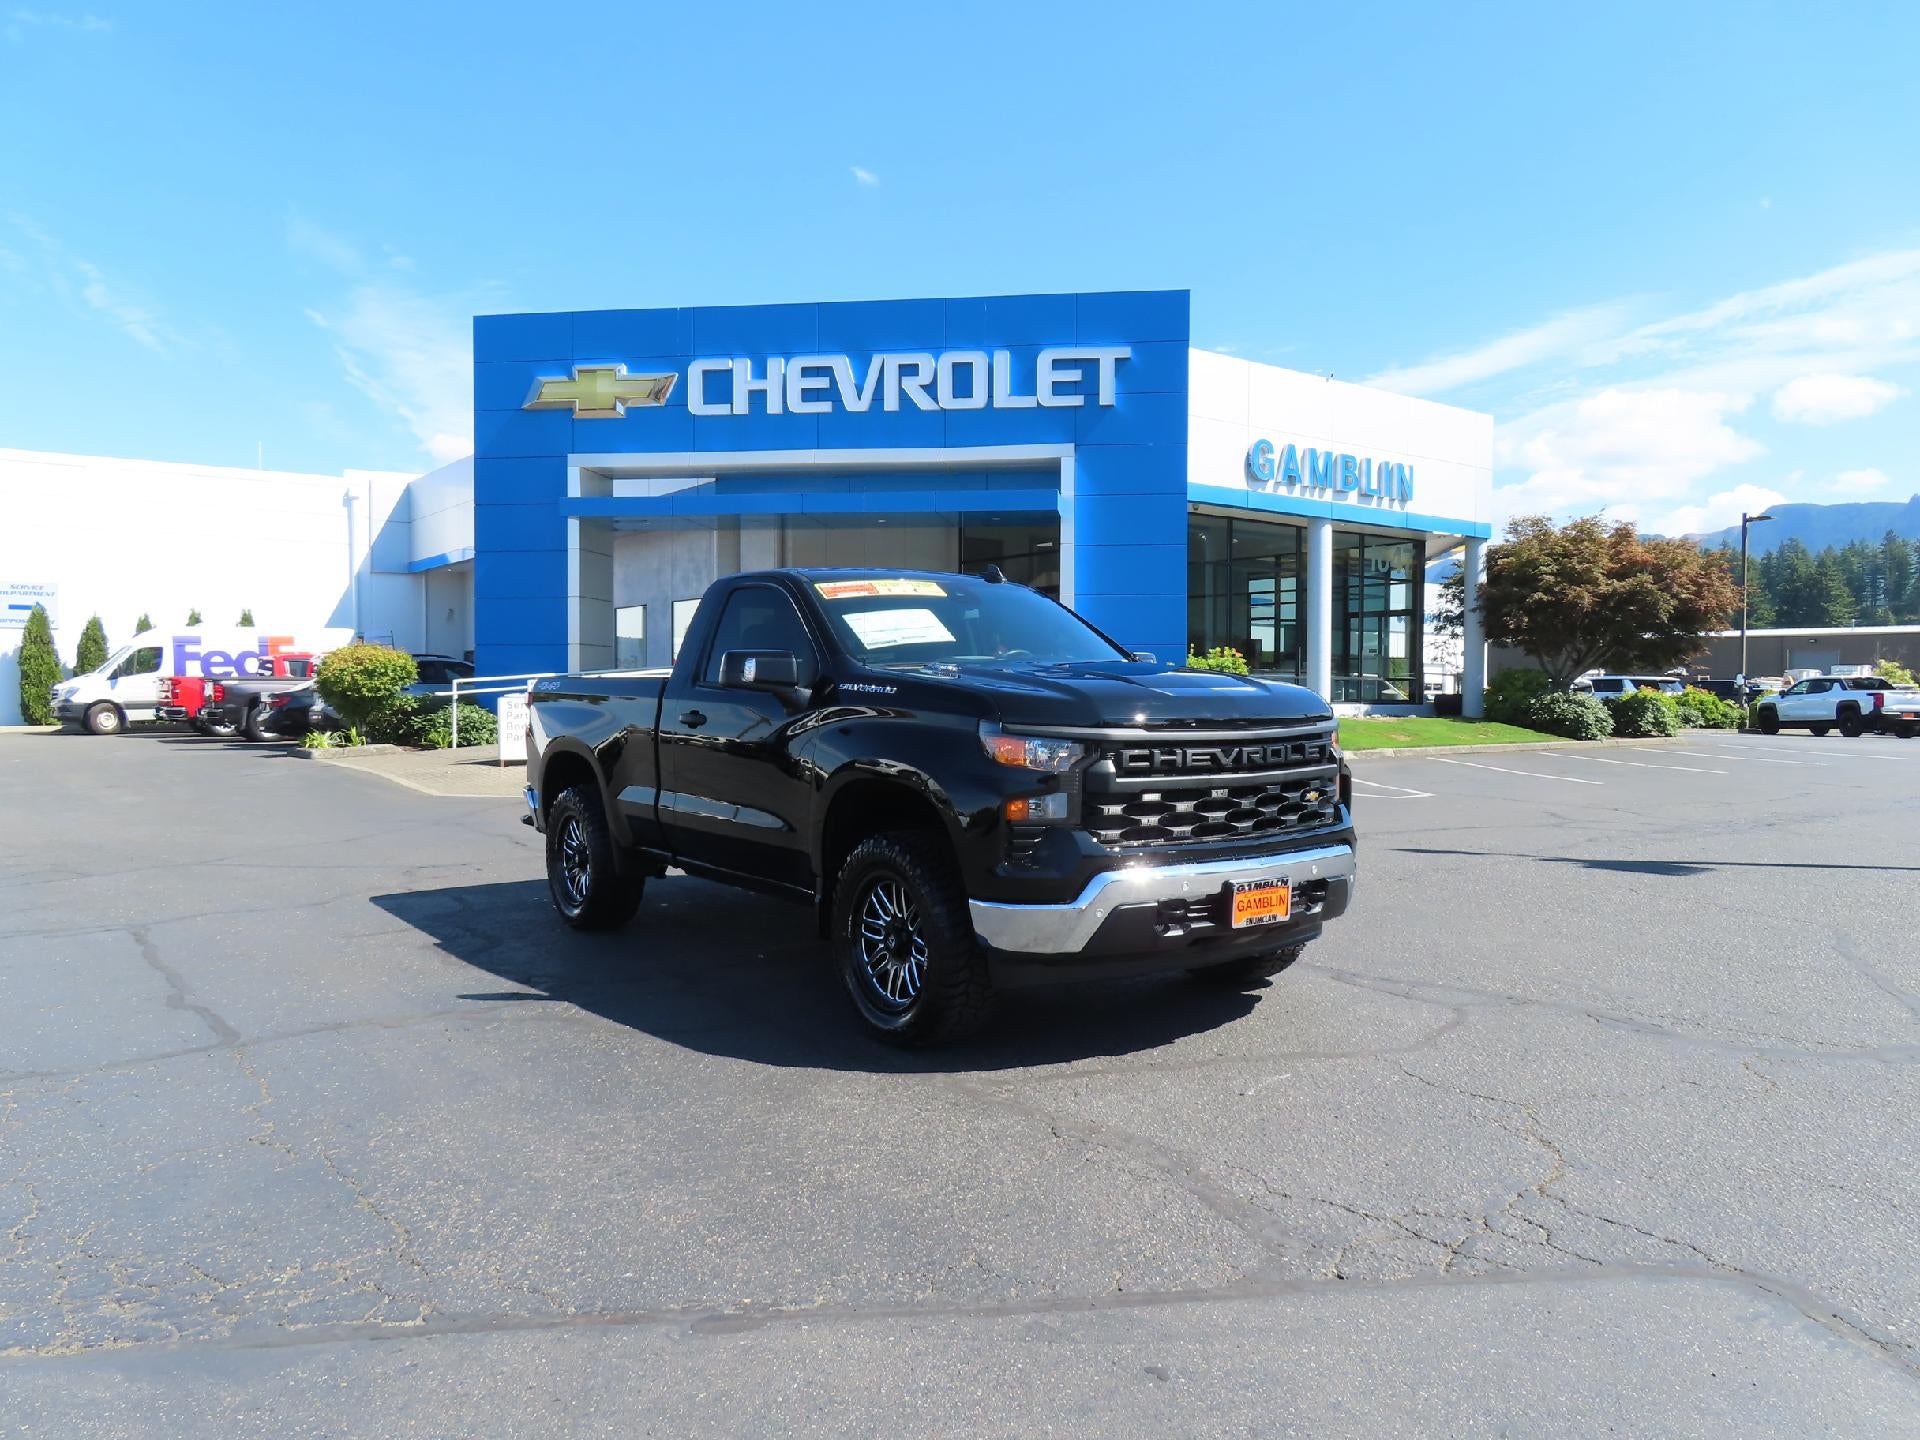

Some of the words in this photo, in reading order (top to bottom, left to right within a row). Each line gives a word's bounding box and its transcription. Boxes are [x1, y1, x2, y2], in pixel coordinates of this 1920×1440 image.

[687, 346, 1132, 416] CHEVROLET
[1246, 438, 1414, 502] GAMBLIN
[1121, 739, 1332, 768] CHEVROLET
[1237, 893, 1286, 912] GAMBLIN
